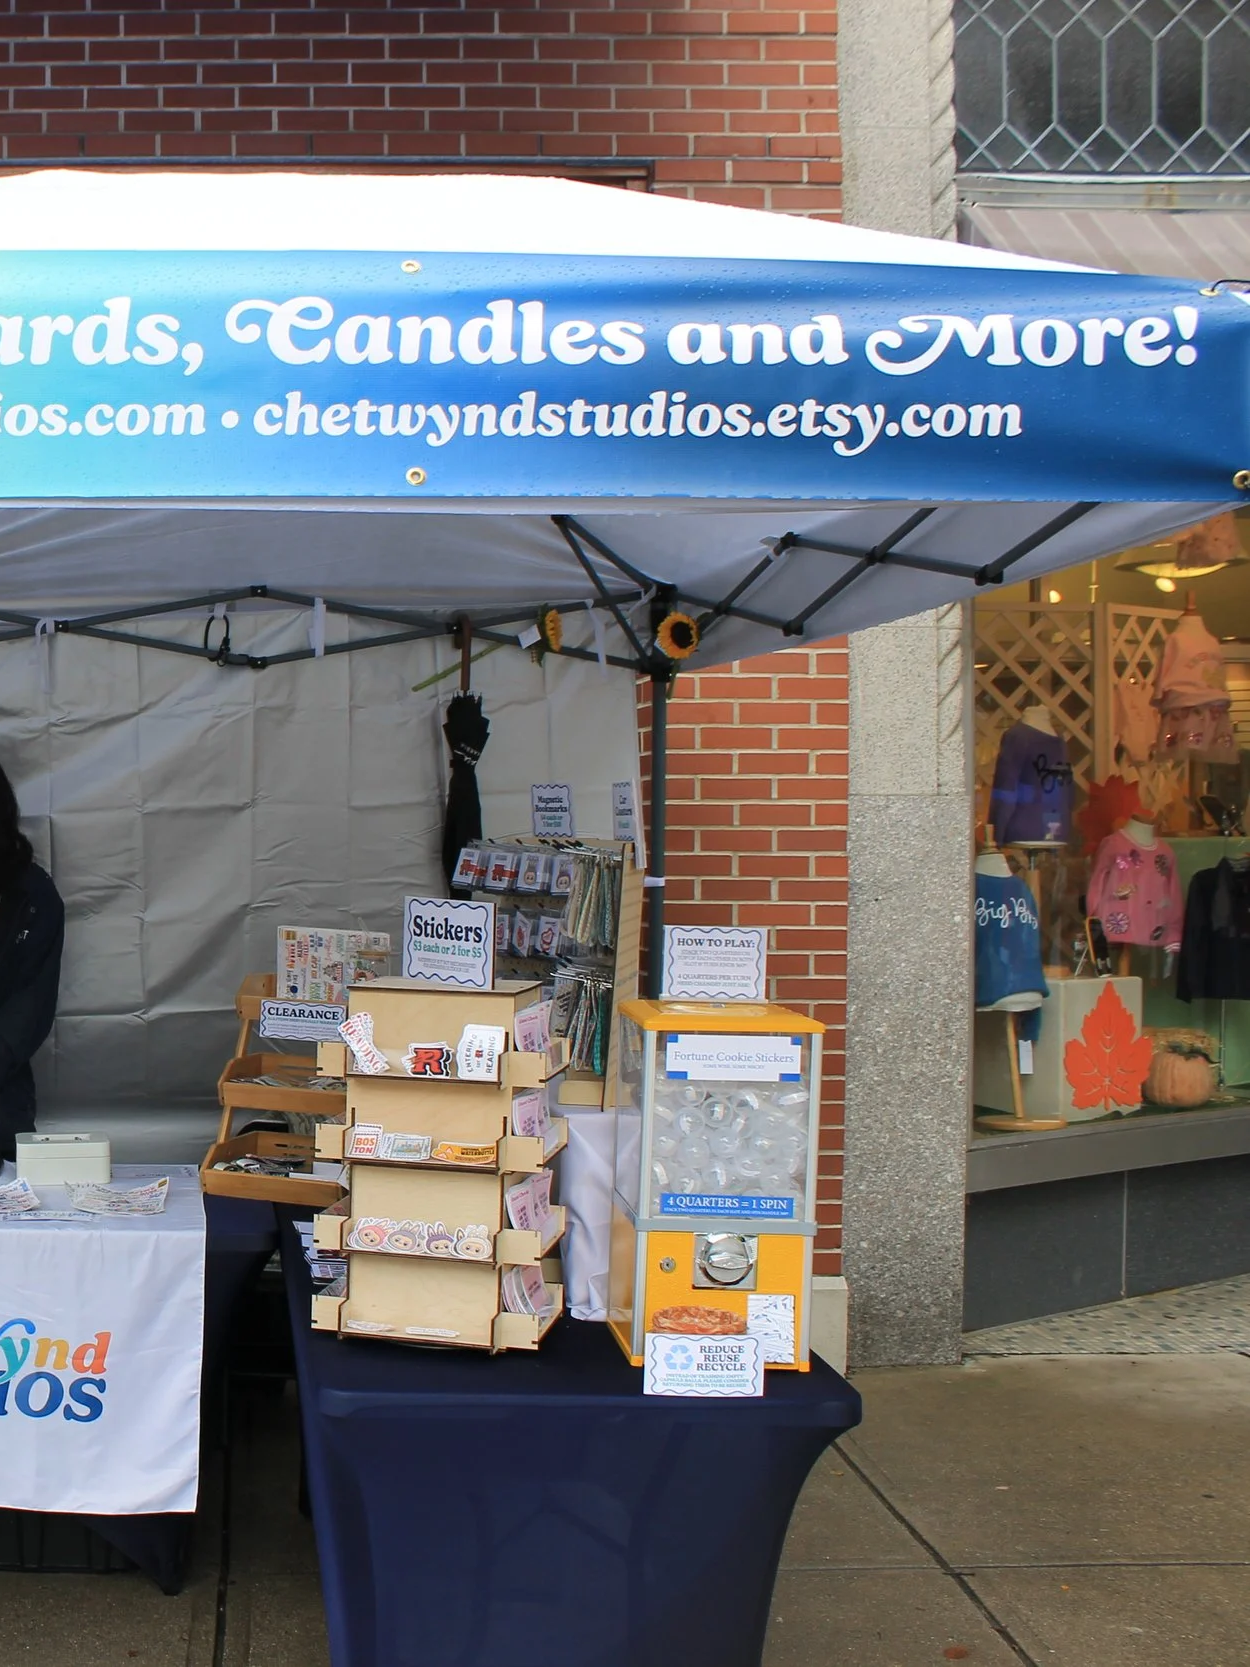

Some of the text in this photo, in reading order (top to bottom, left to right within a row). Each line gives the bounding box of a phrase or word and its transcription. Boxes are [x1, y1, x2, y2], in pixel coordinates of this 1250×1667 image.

[225, 296, 645, 365] Candles
[667, 315, 849, 365] and
[865, 306, 1198, 375] More!
[253, 391, 1021, 456] chetwyndstudios.etsy.com
[412, 914, 483, 943] Stickers
[413, 940, 421, 951] $3
[423, 943, 440, 953] each
[451, 945, 456, 955] 2
[457, 945, 470, 957] for
[471, 946, 482, 958] $5
[677, 938, 755, 948] HOW TO PLAY:
[267, 1006, 339, 1021] CLEARANCE
[465, 1033, 478, 1073] ENTERING
[486, 1035, 496, 1073] READING
[674, 1051, 795, 1063] Fortune Cookie Stickers
[410, 1047, 445, 1076] R
[355, 1137, 375, 1147] BOS
[353, 1145, 372, 1154] TON
[667, 1196, 673, 1206] 4
[676, 1196, 739, 1208] QUARTERS
[752, 1199, 757, 1209] 1
[759, 1199, 787, 1210] SPIN
[699, 1345, 745, 1354] REDUCE
[703, 1354, 740, 1363] REUSE
[696, 1362, 747, 1372] RECYCLE
